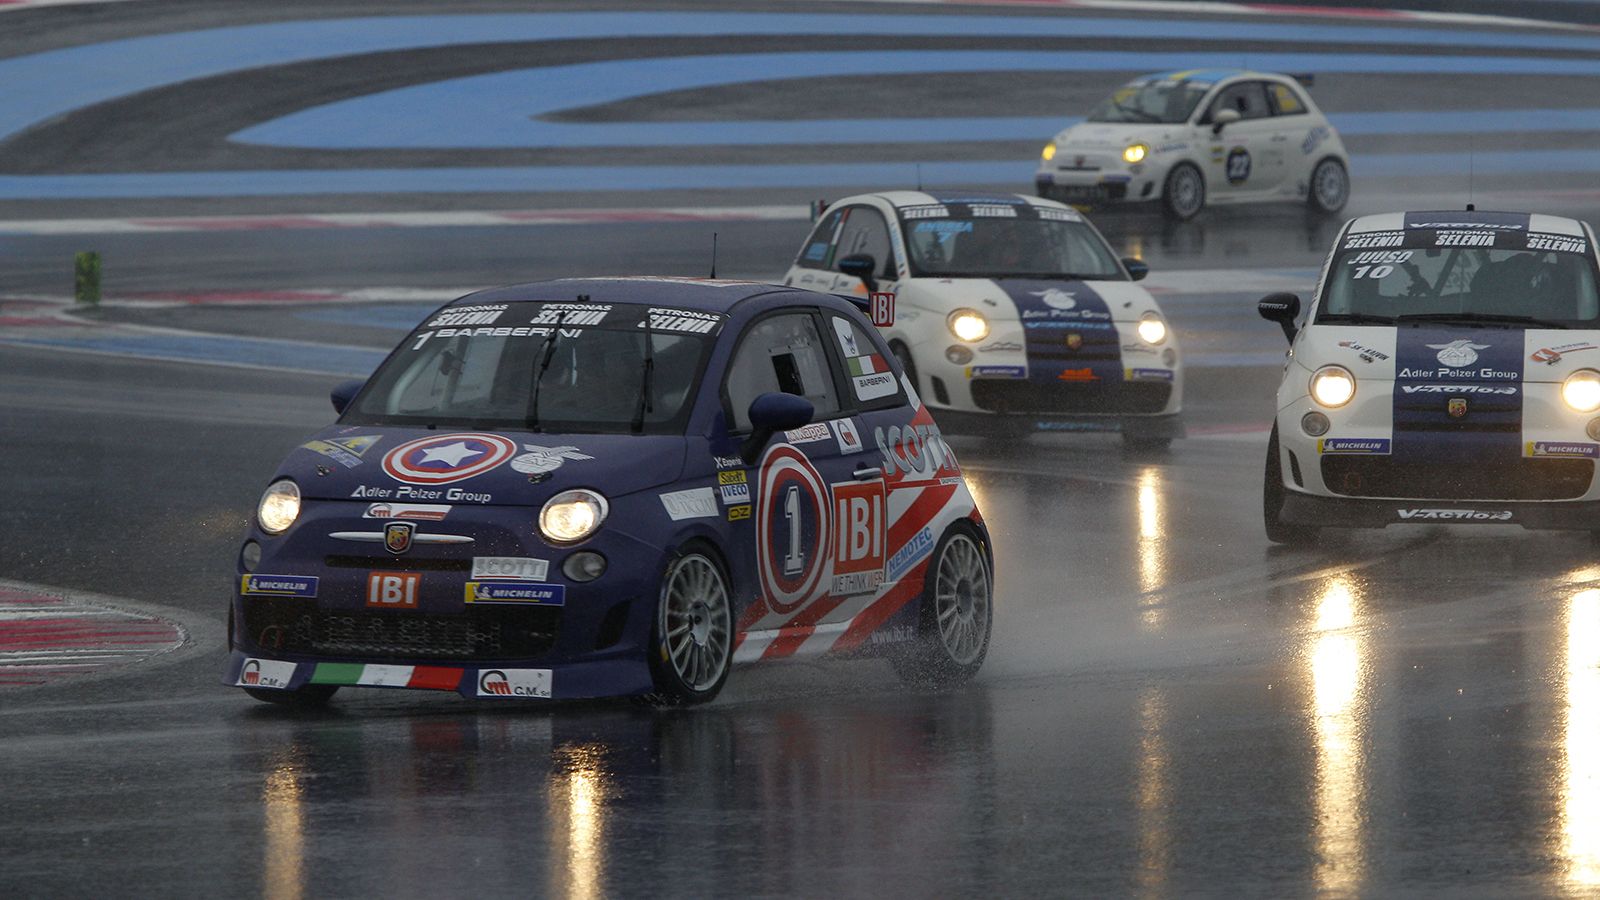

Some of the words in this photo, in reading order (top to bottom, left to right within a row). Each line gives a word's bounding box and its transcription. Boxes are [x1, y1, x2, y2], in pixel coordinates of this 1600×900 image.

[1347, 231, 1405, 239] PETRONAS
[1435, 235, 1496, 247] SELENIA
[1527, 233, 1586, 244] PETRONAS
[1344, 236, 1405, 249] SELENIA
[1527, 238, 1586, 254] SELENIA
[1347, 250, 1414, 264] JUUSO
[1353, 265, 1394, 279] 10
[441, 304, 509, 315] PETRONAS
[541, 303, 613, 312] PETRONAS
[647, 307, 721, 321] PETRONAS
[873, 294, 894, 325] IBI
[428, 311, 504, 326] SELENIA
[412, 330, 434, 351] 1
[1398, 367, 1434, 378] Adler
[1438, 368, 1476, 378] Pelzer
[1480, 368, 1519, 380] Group
[859, 376, 891, 388] BARBERINI
[1335, 441, 1382, 450] MICHELIN
[1548, 446, 1594, 454] MICHELIN
[350, 485, 393, 498] Adler
[396, 486, 443, 499] Pelzer
[446, 488, 492, 504] Group
[722, 484, 747, 497] IVECO
[784, 485, 804, 576] 1
[838, 494, 881, 562] IBI
[474, 559, 545, 576] SCOTTI
[258, 580, 308, 591] MICHELIN
[370, 575, 416, 604] IBI
[492, 589, 553, 599] MICHELIN
